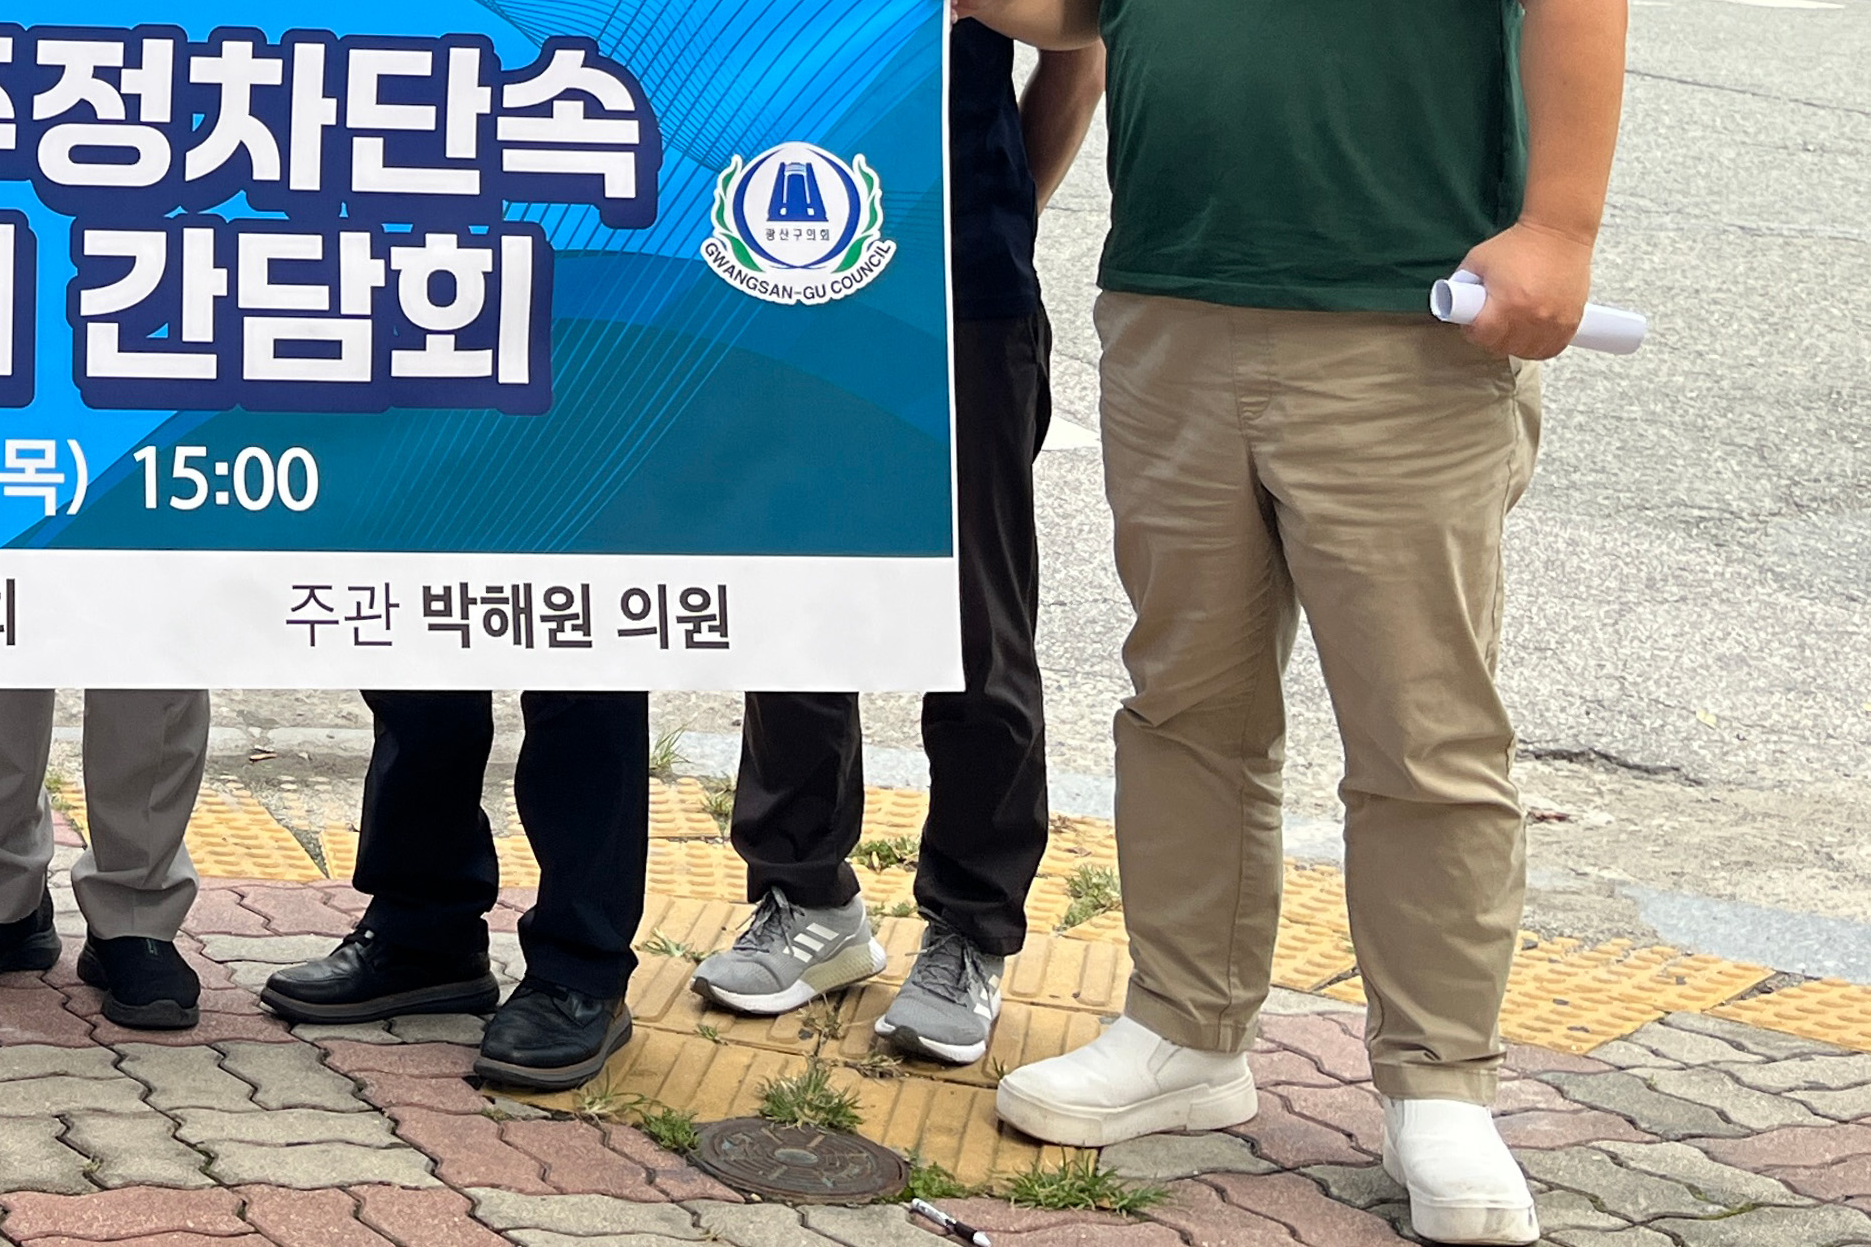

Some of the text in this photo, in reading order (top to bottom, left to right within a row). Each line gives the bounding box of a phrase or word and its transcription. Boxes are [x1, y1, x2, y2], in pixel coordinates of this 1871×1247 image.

[765, 228, 830, 241] 광산구의회
[705, 242, 892, 300] GWANGSAN-GU COUNCIL
[79, 228, 533, 385] 간담회
[132, 445, 320, 511] 15:00
[285, 582, 399, 648] 주관
[421, 581, 593, 649] 박해원
[617, 583, 731, 650] 의원
